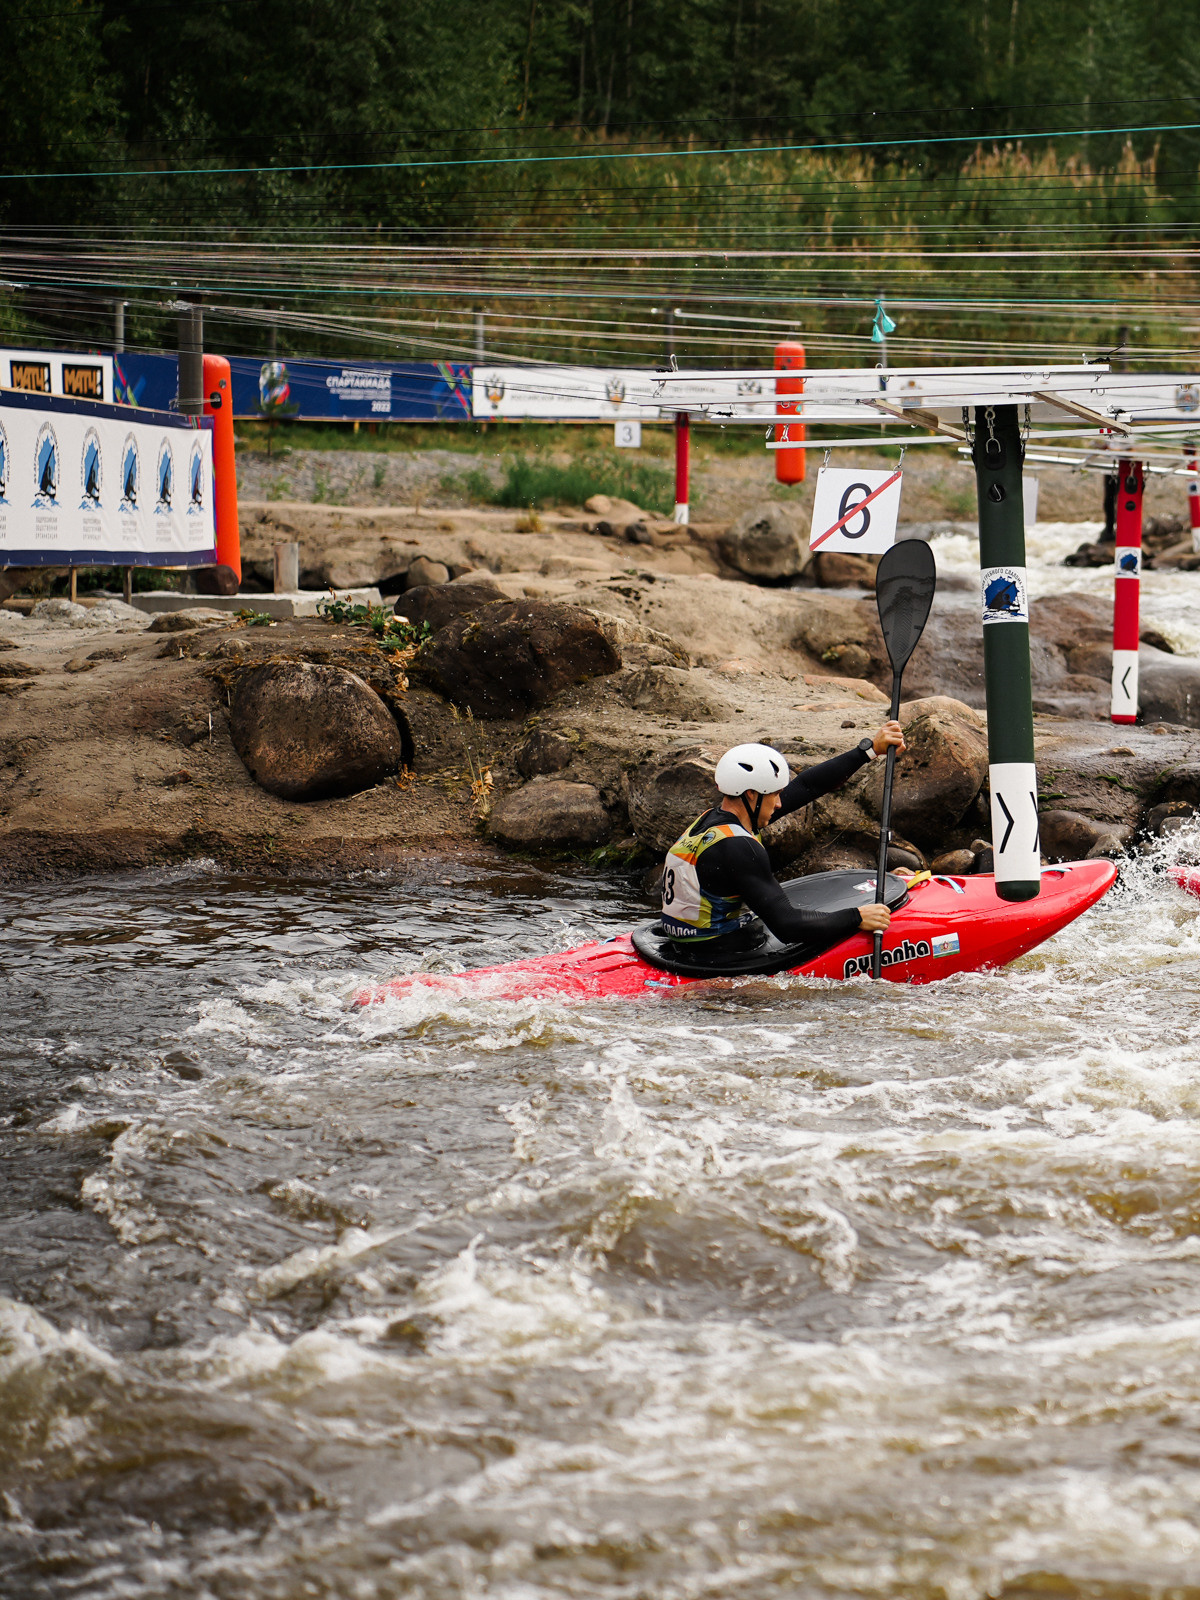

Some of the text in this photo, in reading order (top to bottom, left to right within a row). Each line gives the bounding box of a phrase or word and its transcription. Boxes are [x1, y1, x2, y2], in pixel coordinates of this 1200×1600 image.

[326, 376, 392, 389] СПАРТАКИАДА
[622, 426, 633, 443] 3
[838, 482, 871, 539] 6
